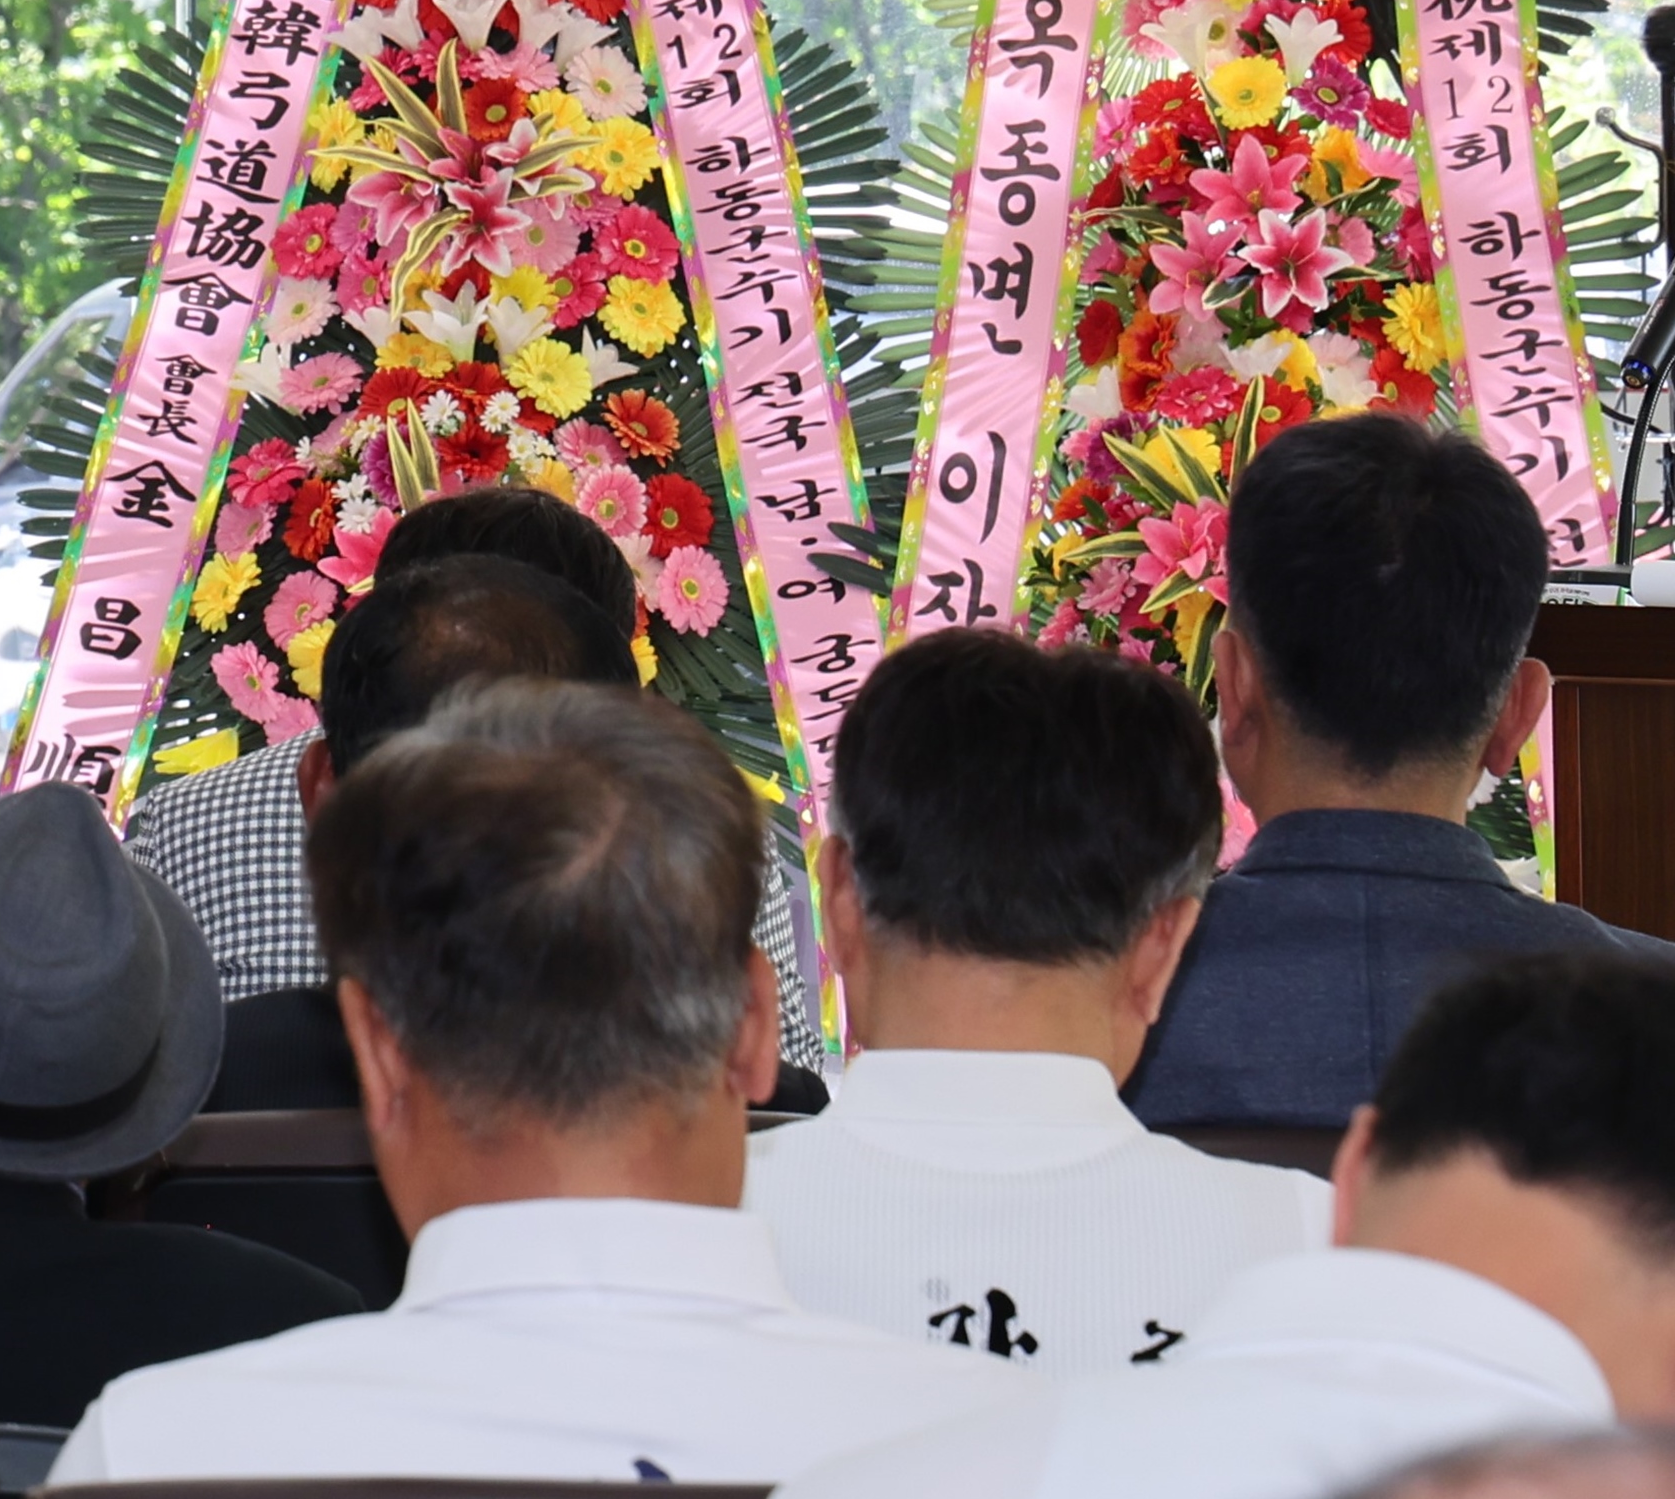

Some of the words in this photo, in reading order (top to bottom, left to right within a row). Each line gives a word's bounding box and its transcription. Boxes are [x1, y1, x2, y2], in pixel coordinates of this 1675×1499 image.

[1427, 18, 1517, 174] 제12회
[685, 136, 799, 350] 하동군수기
[1459, 210, 1574, 483] 하동군수기
